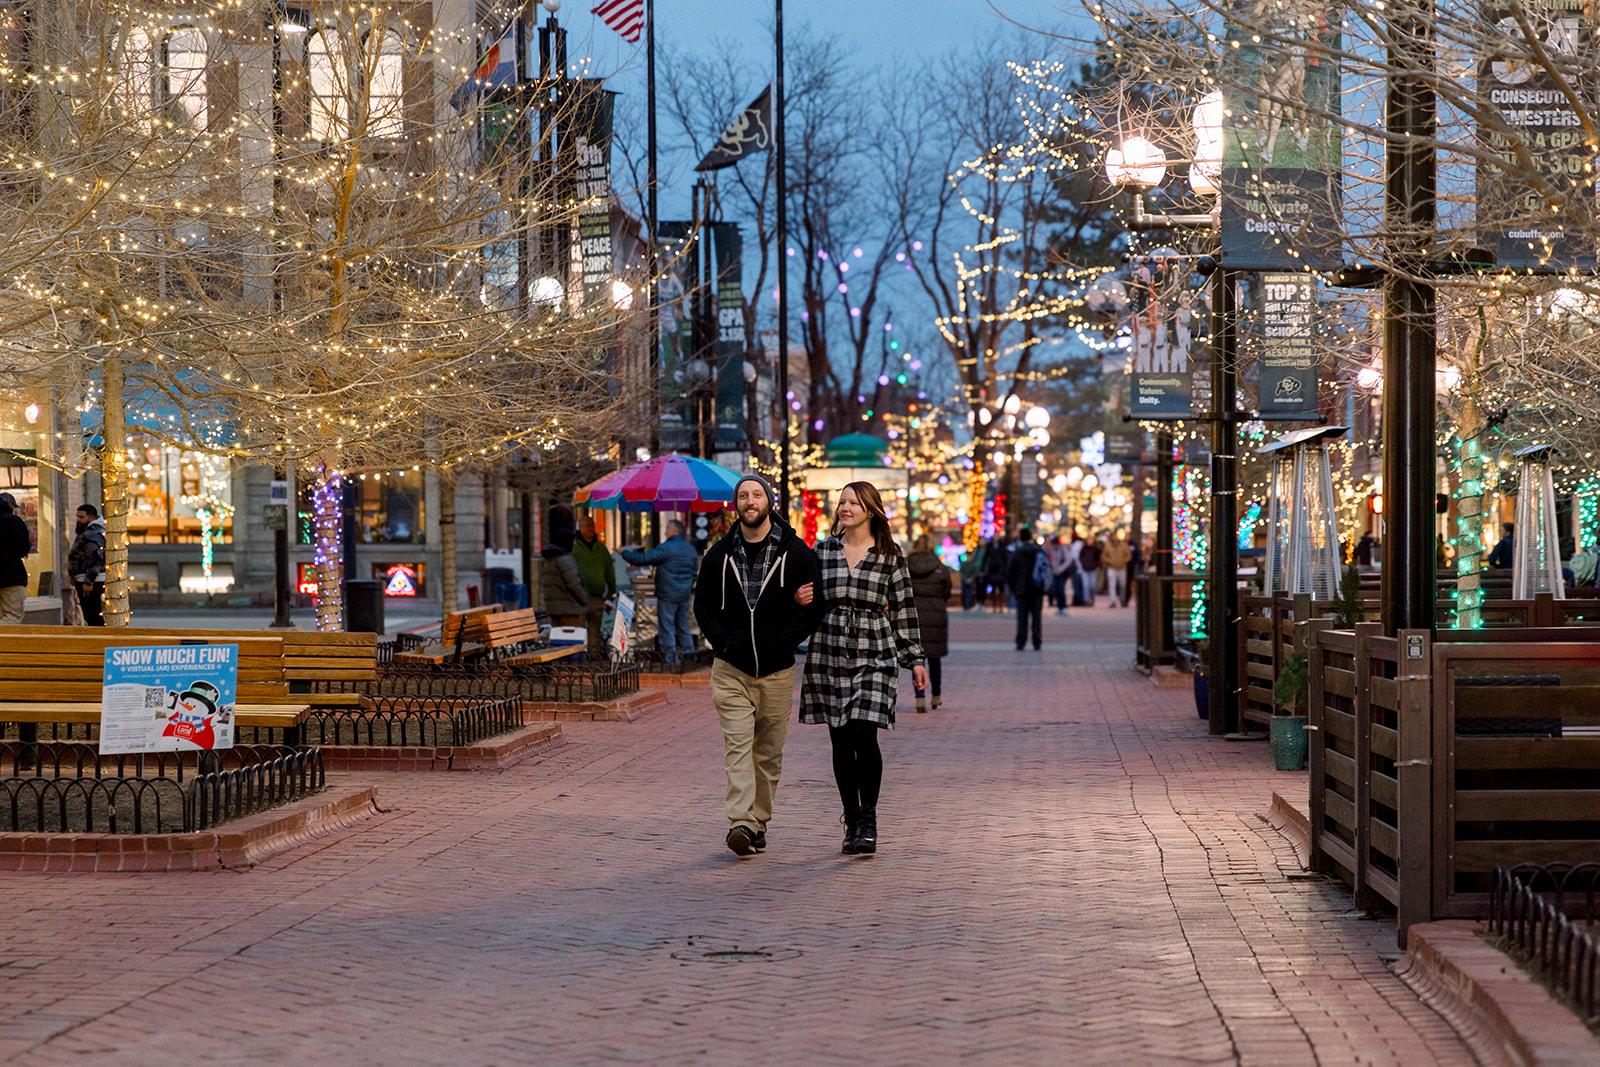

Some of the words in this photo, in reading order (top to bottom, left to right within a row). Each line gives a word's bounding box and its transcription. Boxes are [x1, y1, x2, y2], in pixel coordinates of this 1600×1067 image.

[1502, 110, 1582, 126] EMESTERS
[1508, 229, 1564, 239] cubuffsom
[582, 237, 611, 255] PEACE
[583, 255, 613, 272] CORPS
[1264, 283, 1297, 301] TOP
[1300, 284, 1311, 300] 3
[718, 308, 745, 327] GPA
[1264, 326, 1311, 337] SCHOOLS
[1265, 347, 1312, 357] RESEARCH
[1139, 377, 1182, 387] Community.
[1139, 396, 1160, 405] Unity.
[112, 649, 153, 666] SNOW
[156, 648, 197, 665] MUCH
[200, 647, 230, 664] FUN!
[127, 665, 155, 673] VIRTUAL
[171, 664, 216, 672] EXPERIENCES
